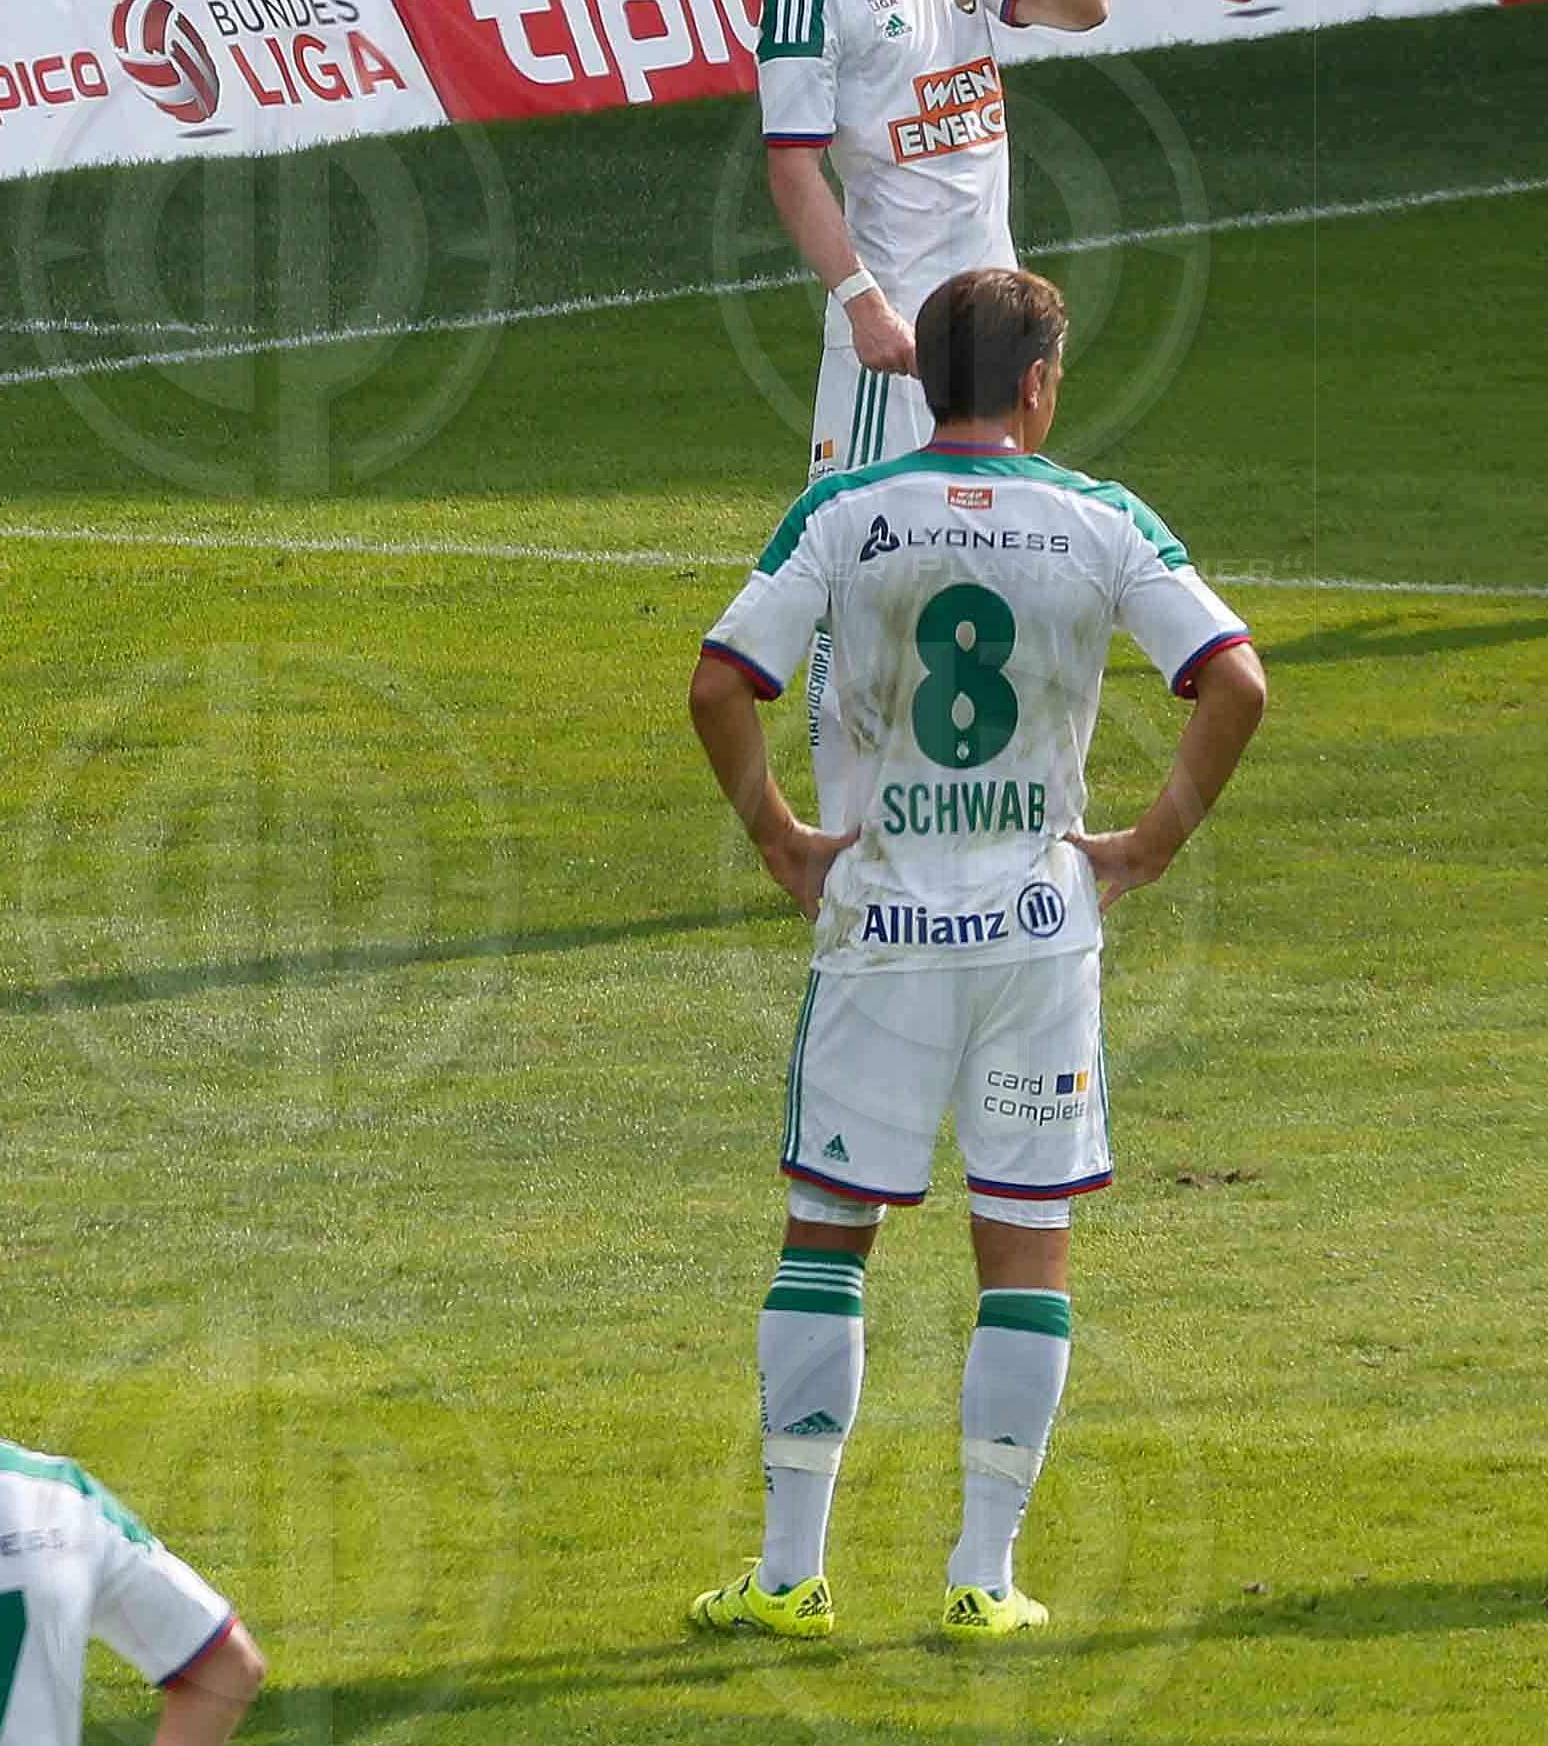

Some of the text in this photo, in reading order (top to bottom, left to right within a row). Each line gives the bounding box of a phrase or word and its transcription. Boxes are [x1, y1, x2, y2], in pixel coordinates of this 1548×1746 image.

[227, 30, 409, 107] LIGA
[906, 526, 1071, 554] LYONESS
[911, 582, 1019, 771] 8
[881, 780, 1047, 836] SCHWAB
[861, 902, 1009, 946] Allianz
[986, 1068, 1044, 1096] card
[983, 1094, 1087, 1127] complete
